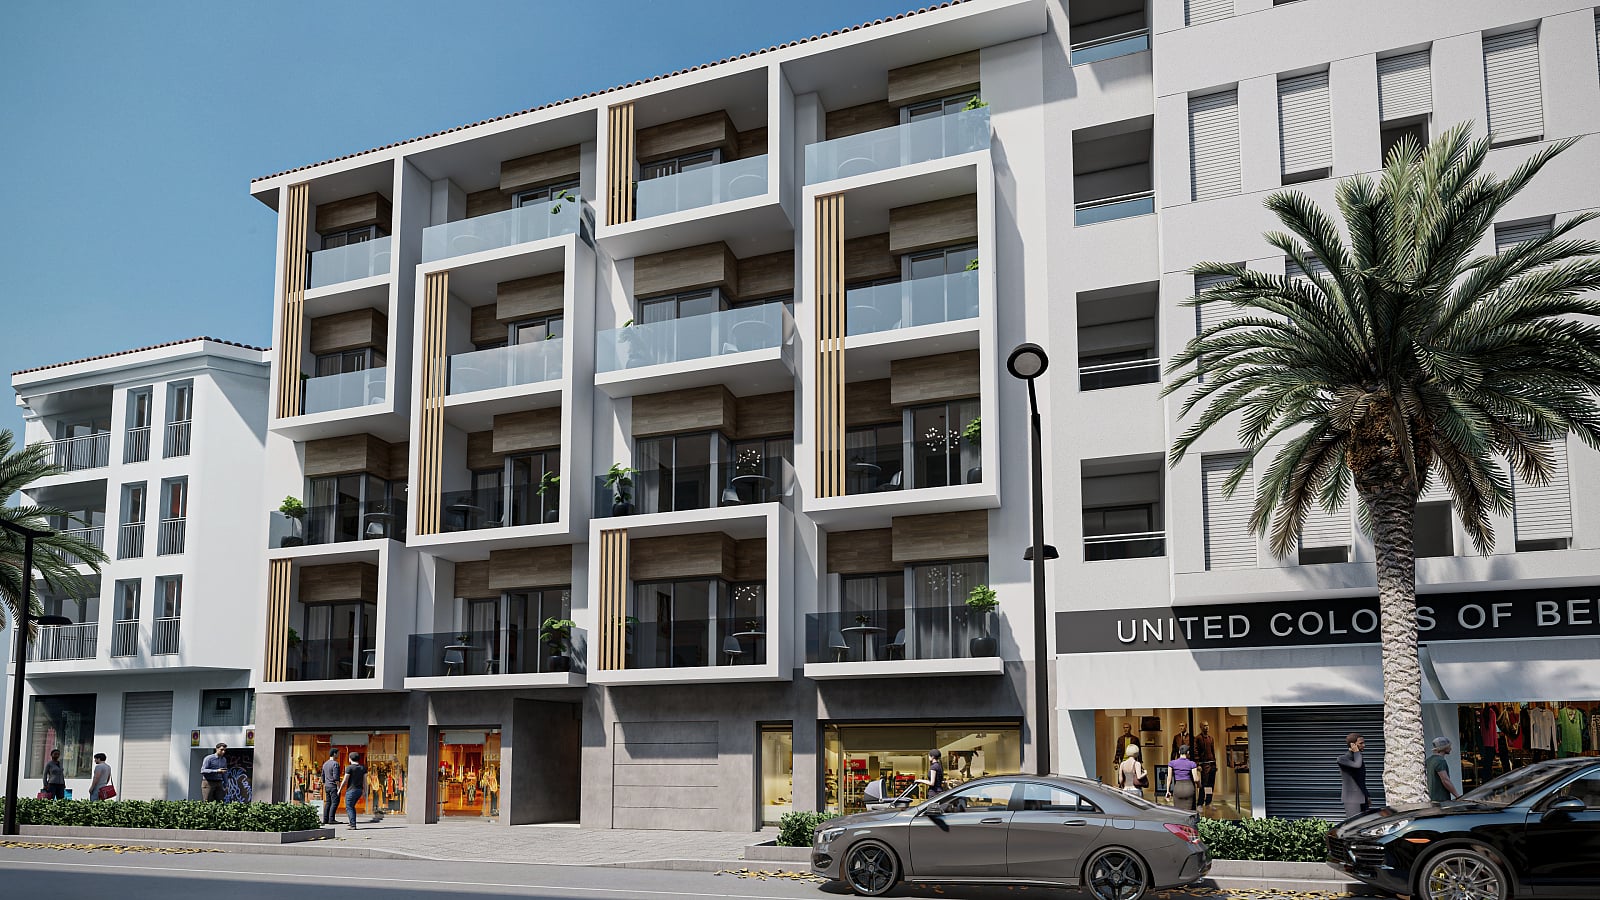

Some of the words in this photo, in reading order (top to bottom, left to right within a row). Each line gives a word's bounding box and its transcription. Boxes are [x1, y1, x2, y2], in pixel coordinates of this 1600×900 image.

[1117, 614, 1250, 643] UNITED
[1270, 606, 1437, 637] COLOS
[1457, 602, 1513, 630] OF
[1536, 598, 1600, 627] BE
